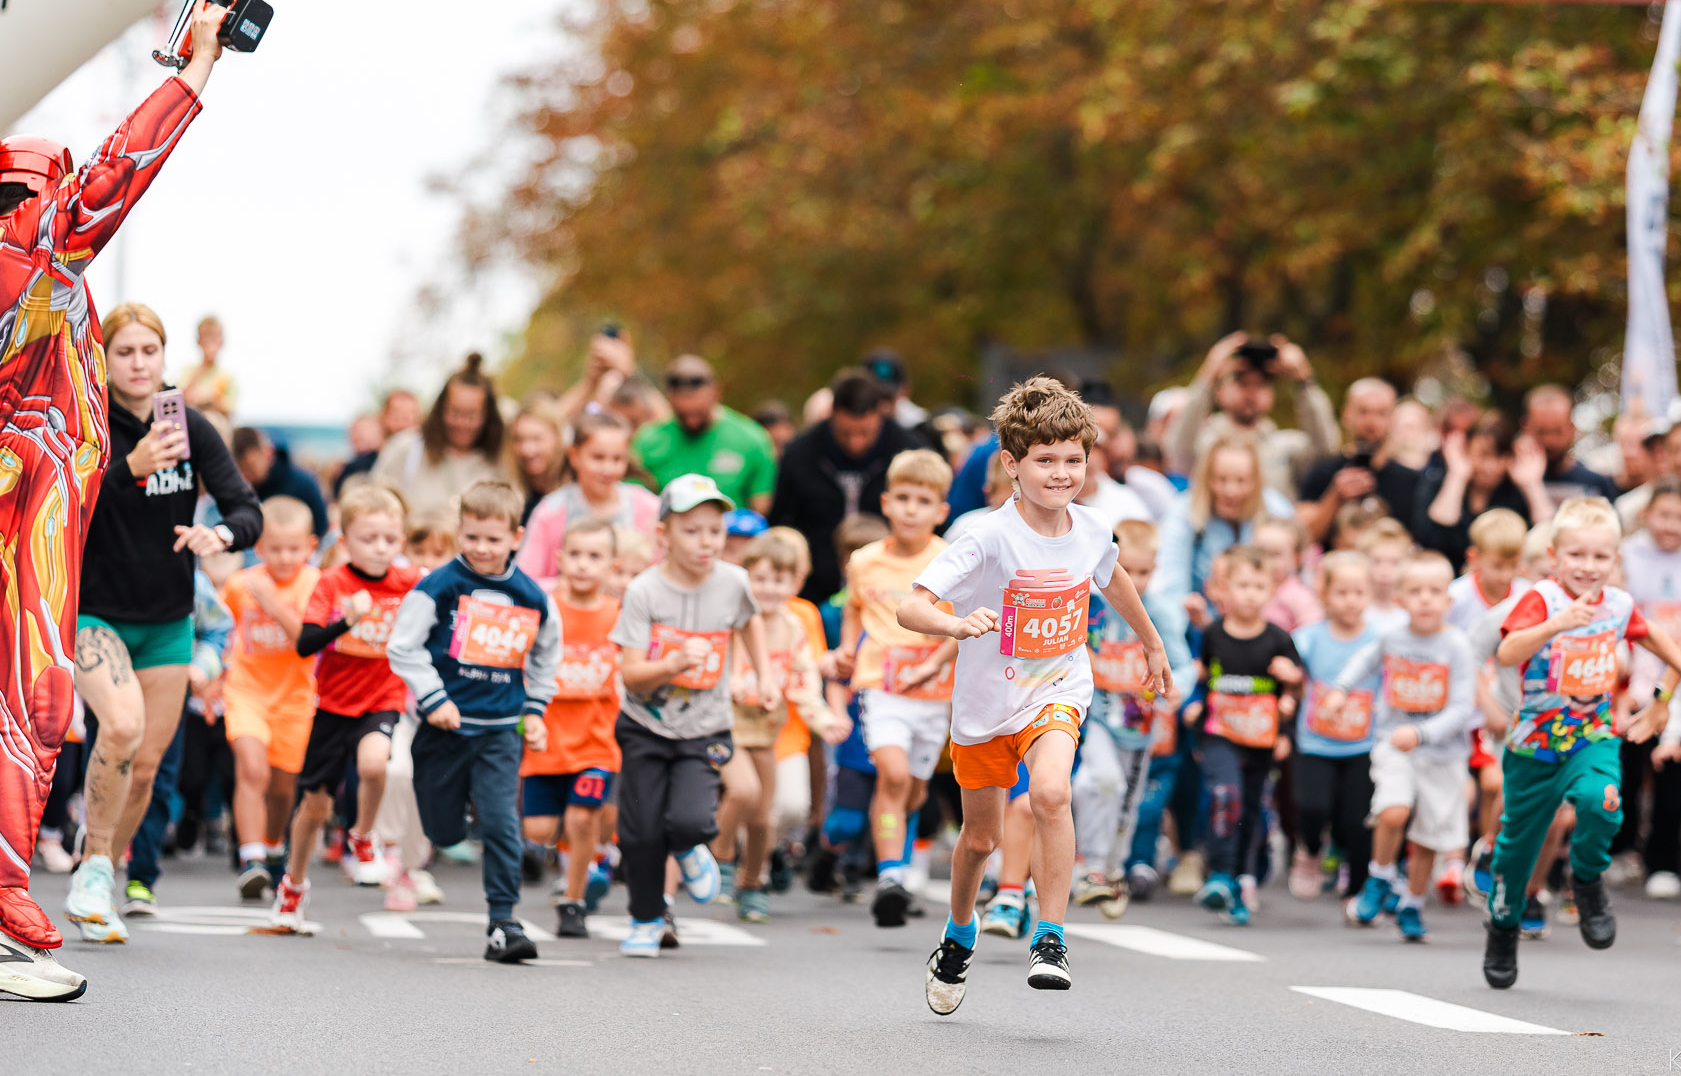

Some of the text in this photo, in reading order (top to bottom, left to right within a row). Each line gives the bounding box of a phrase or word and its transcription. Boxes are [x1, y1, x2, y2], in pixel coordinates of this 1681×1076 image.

[1004, 615, 1014, 637] 400m
[1022, 607, 1083, 639] 4057
[471, 624, 529, 653] 4044
[1042, 634, 1069, 646] JULIAN
[1566, 652, 1616, 679] 4644
